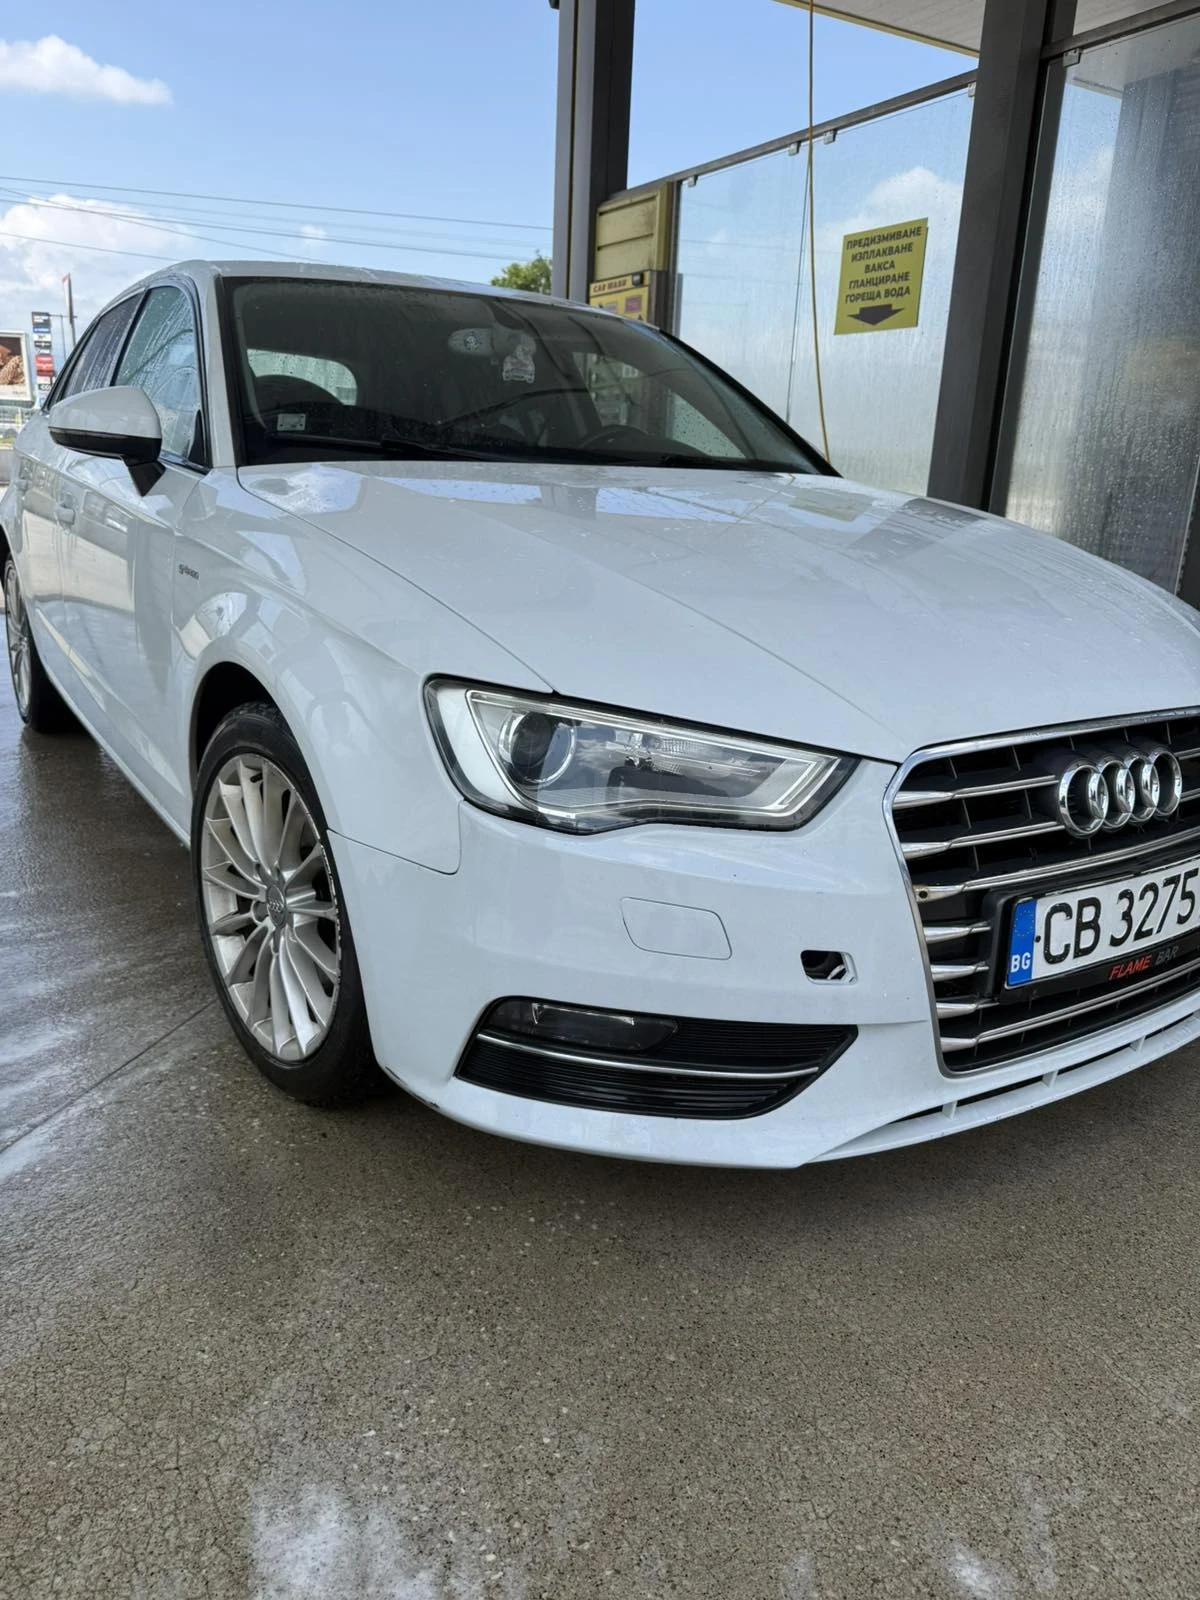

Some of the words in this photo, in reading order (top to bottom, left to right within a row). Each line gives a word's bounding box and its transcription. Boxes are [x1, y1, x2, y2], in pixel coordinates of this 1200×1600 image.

[846, 226, 922, 250] ПРЕДИЗМИВАНЕ
[851, 242, 914, 263] ИЗПЛАКВАНЕ
[864, 260, 896, 274] ВАКСА
[848, 271, 911, 290] ГЛАНЦИРАНЕ
[845, 291, 882, 304] ГОРЕЩА
[884, 286, 911, 298] ВОДА
[1043, 896, 1102, 965] CB
[1109, 867, 1200, 947] 3275
[1010, 952, 1031, 973] BG
[1108, 954, 1152, 981] FLAME
